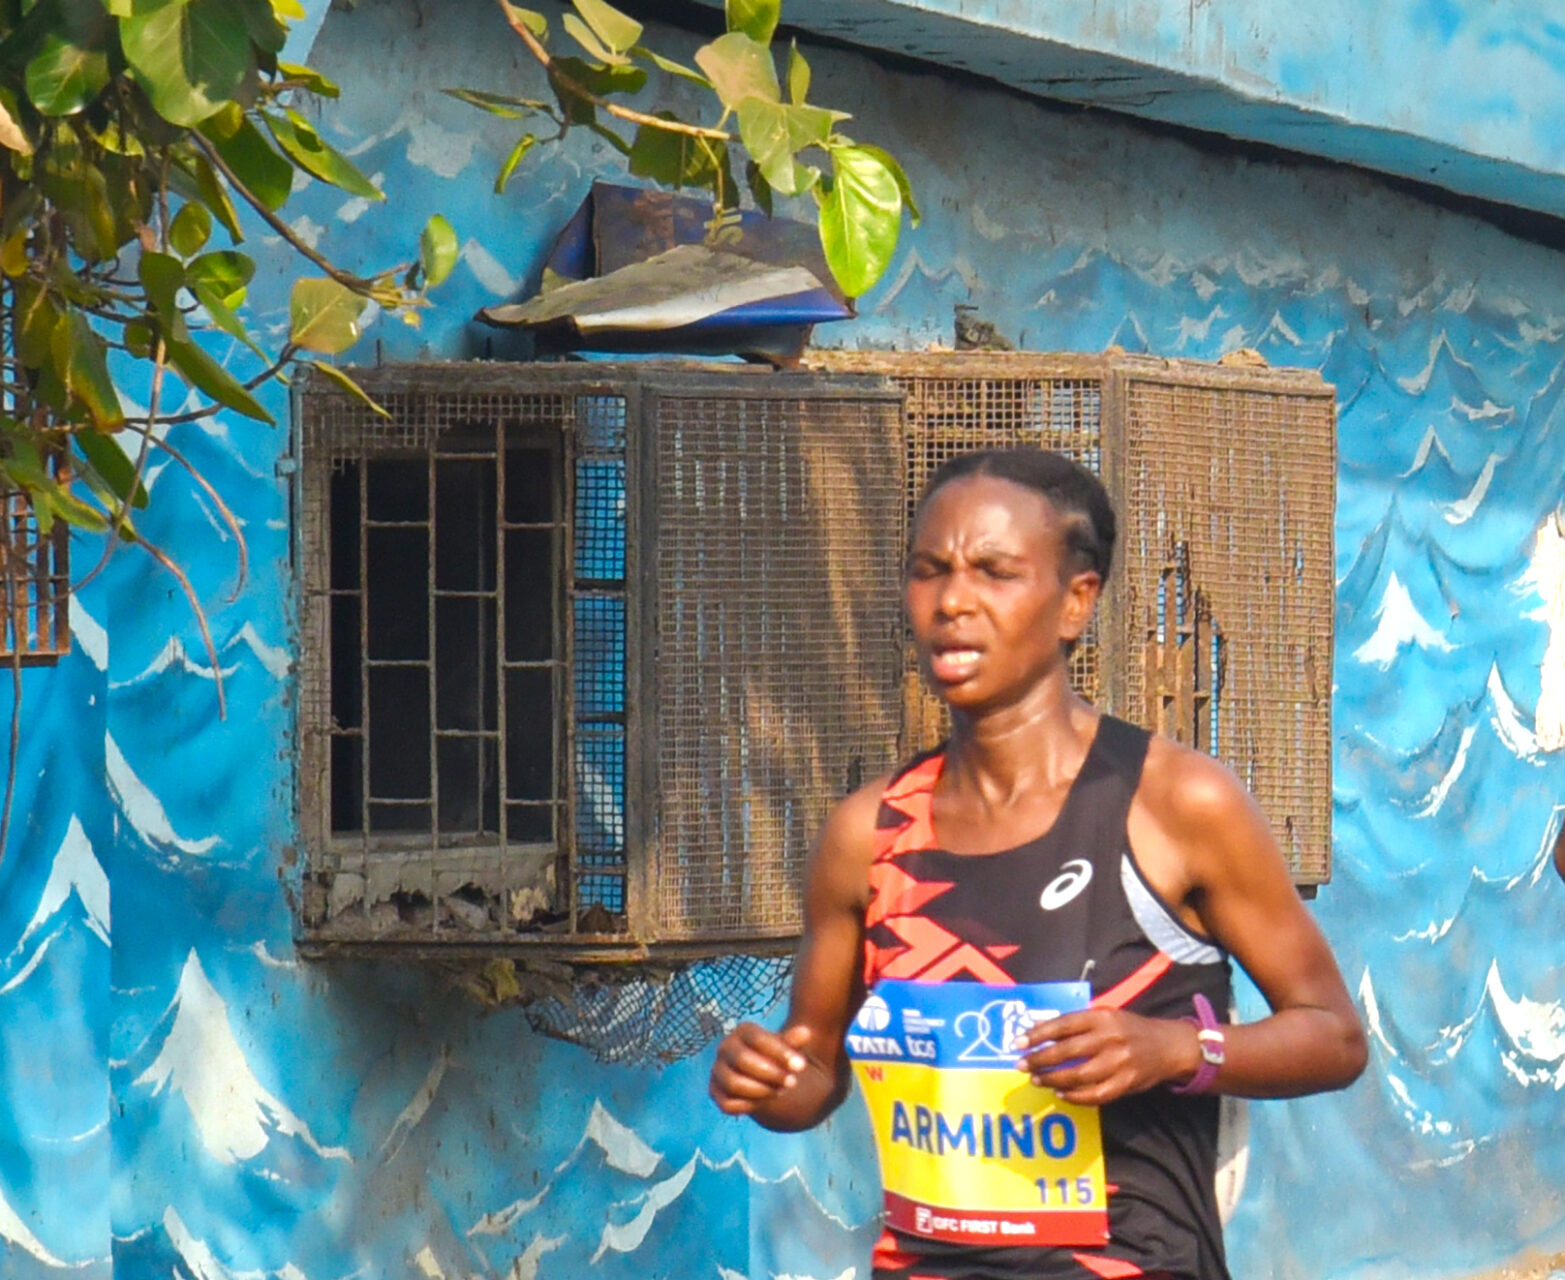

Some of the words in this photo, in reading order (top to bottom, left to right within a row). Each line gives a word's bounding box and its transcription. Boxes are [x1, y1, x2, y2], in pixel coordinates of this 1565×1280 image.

[847, 1035, 903, 1056] TATA
[891, 1100, 1077, 1159] ARMINO
[1035, 1177, 1092, 1204] 115
[961, 1219, 998, 1234] FIRST
[1000, 1220, 1036, 1234] Bank
